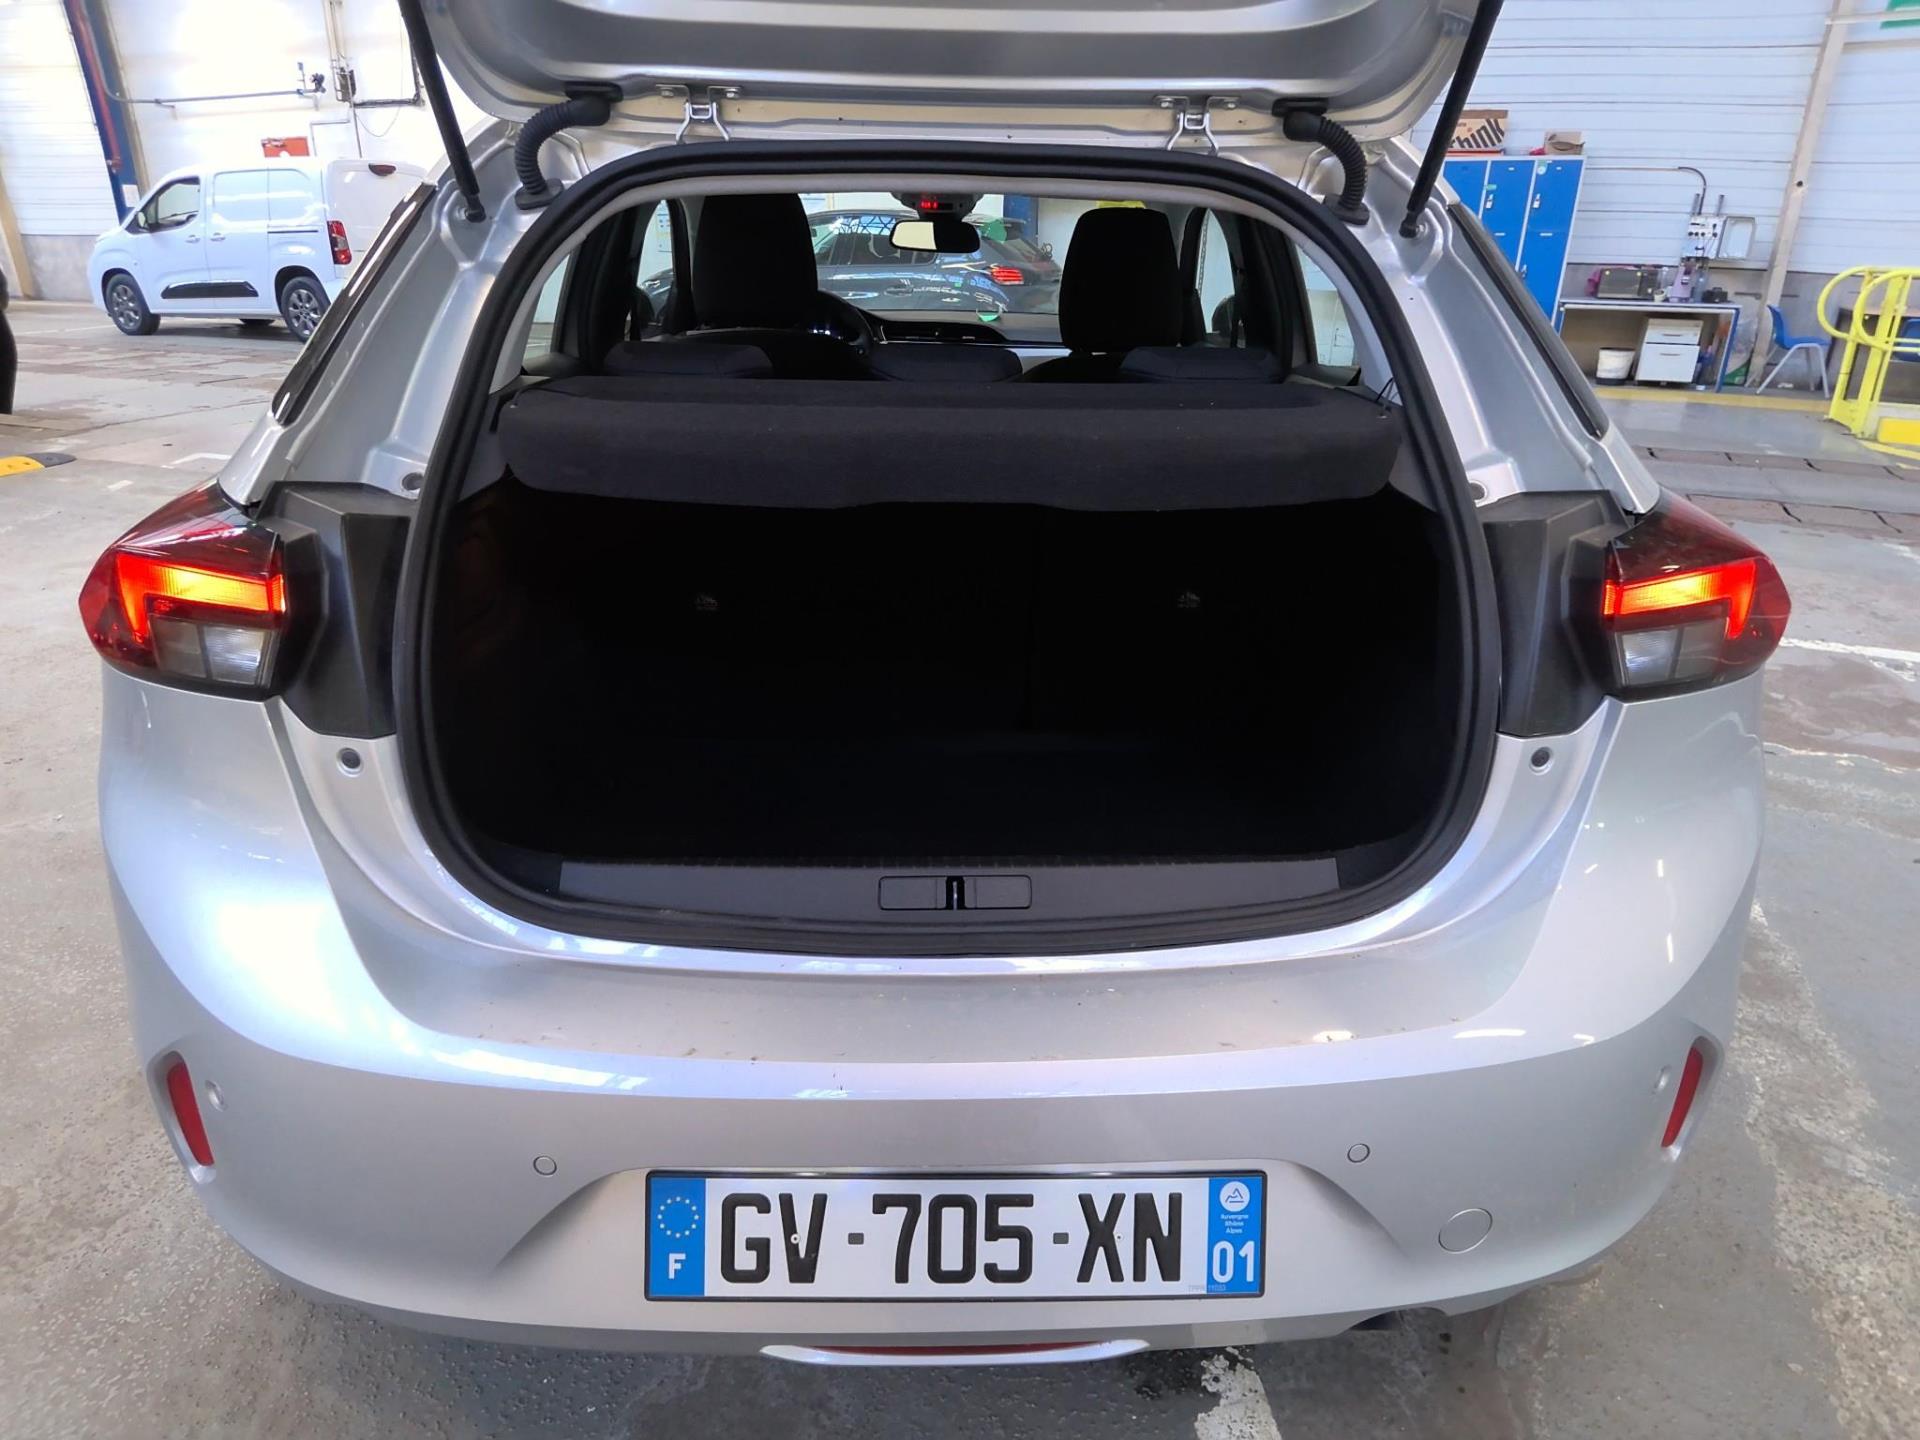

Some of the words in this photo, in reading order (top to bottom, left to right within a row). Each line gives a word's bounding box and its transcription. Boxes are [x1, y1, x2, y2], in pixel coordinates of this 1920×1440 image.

[1450, 118, 1505, 149] hink
[667, 1252, 686, 1279] F
[1212, 1240, 1255, 1283] 01
